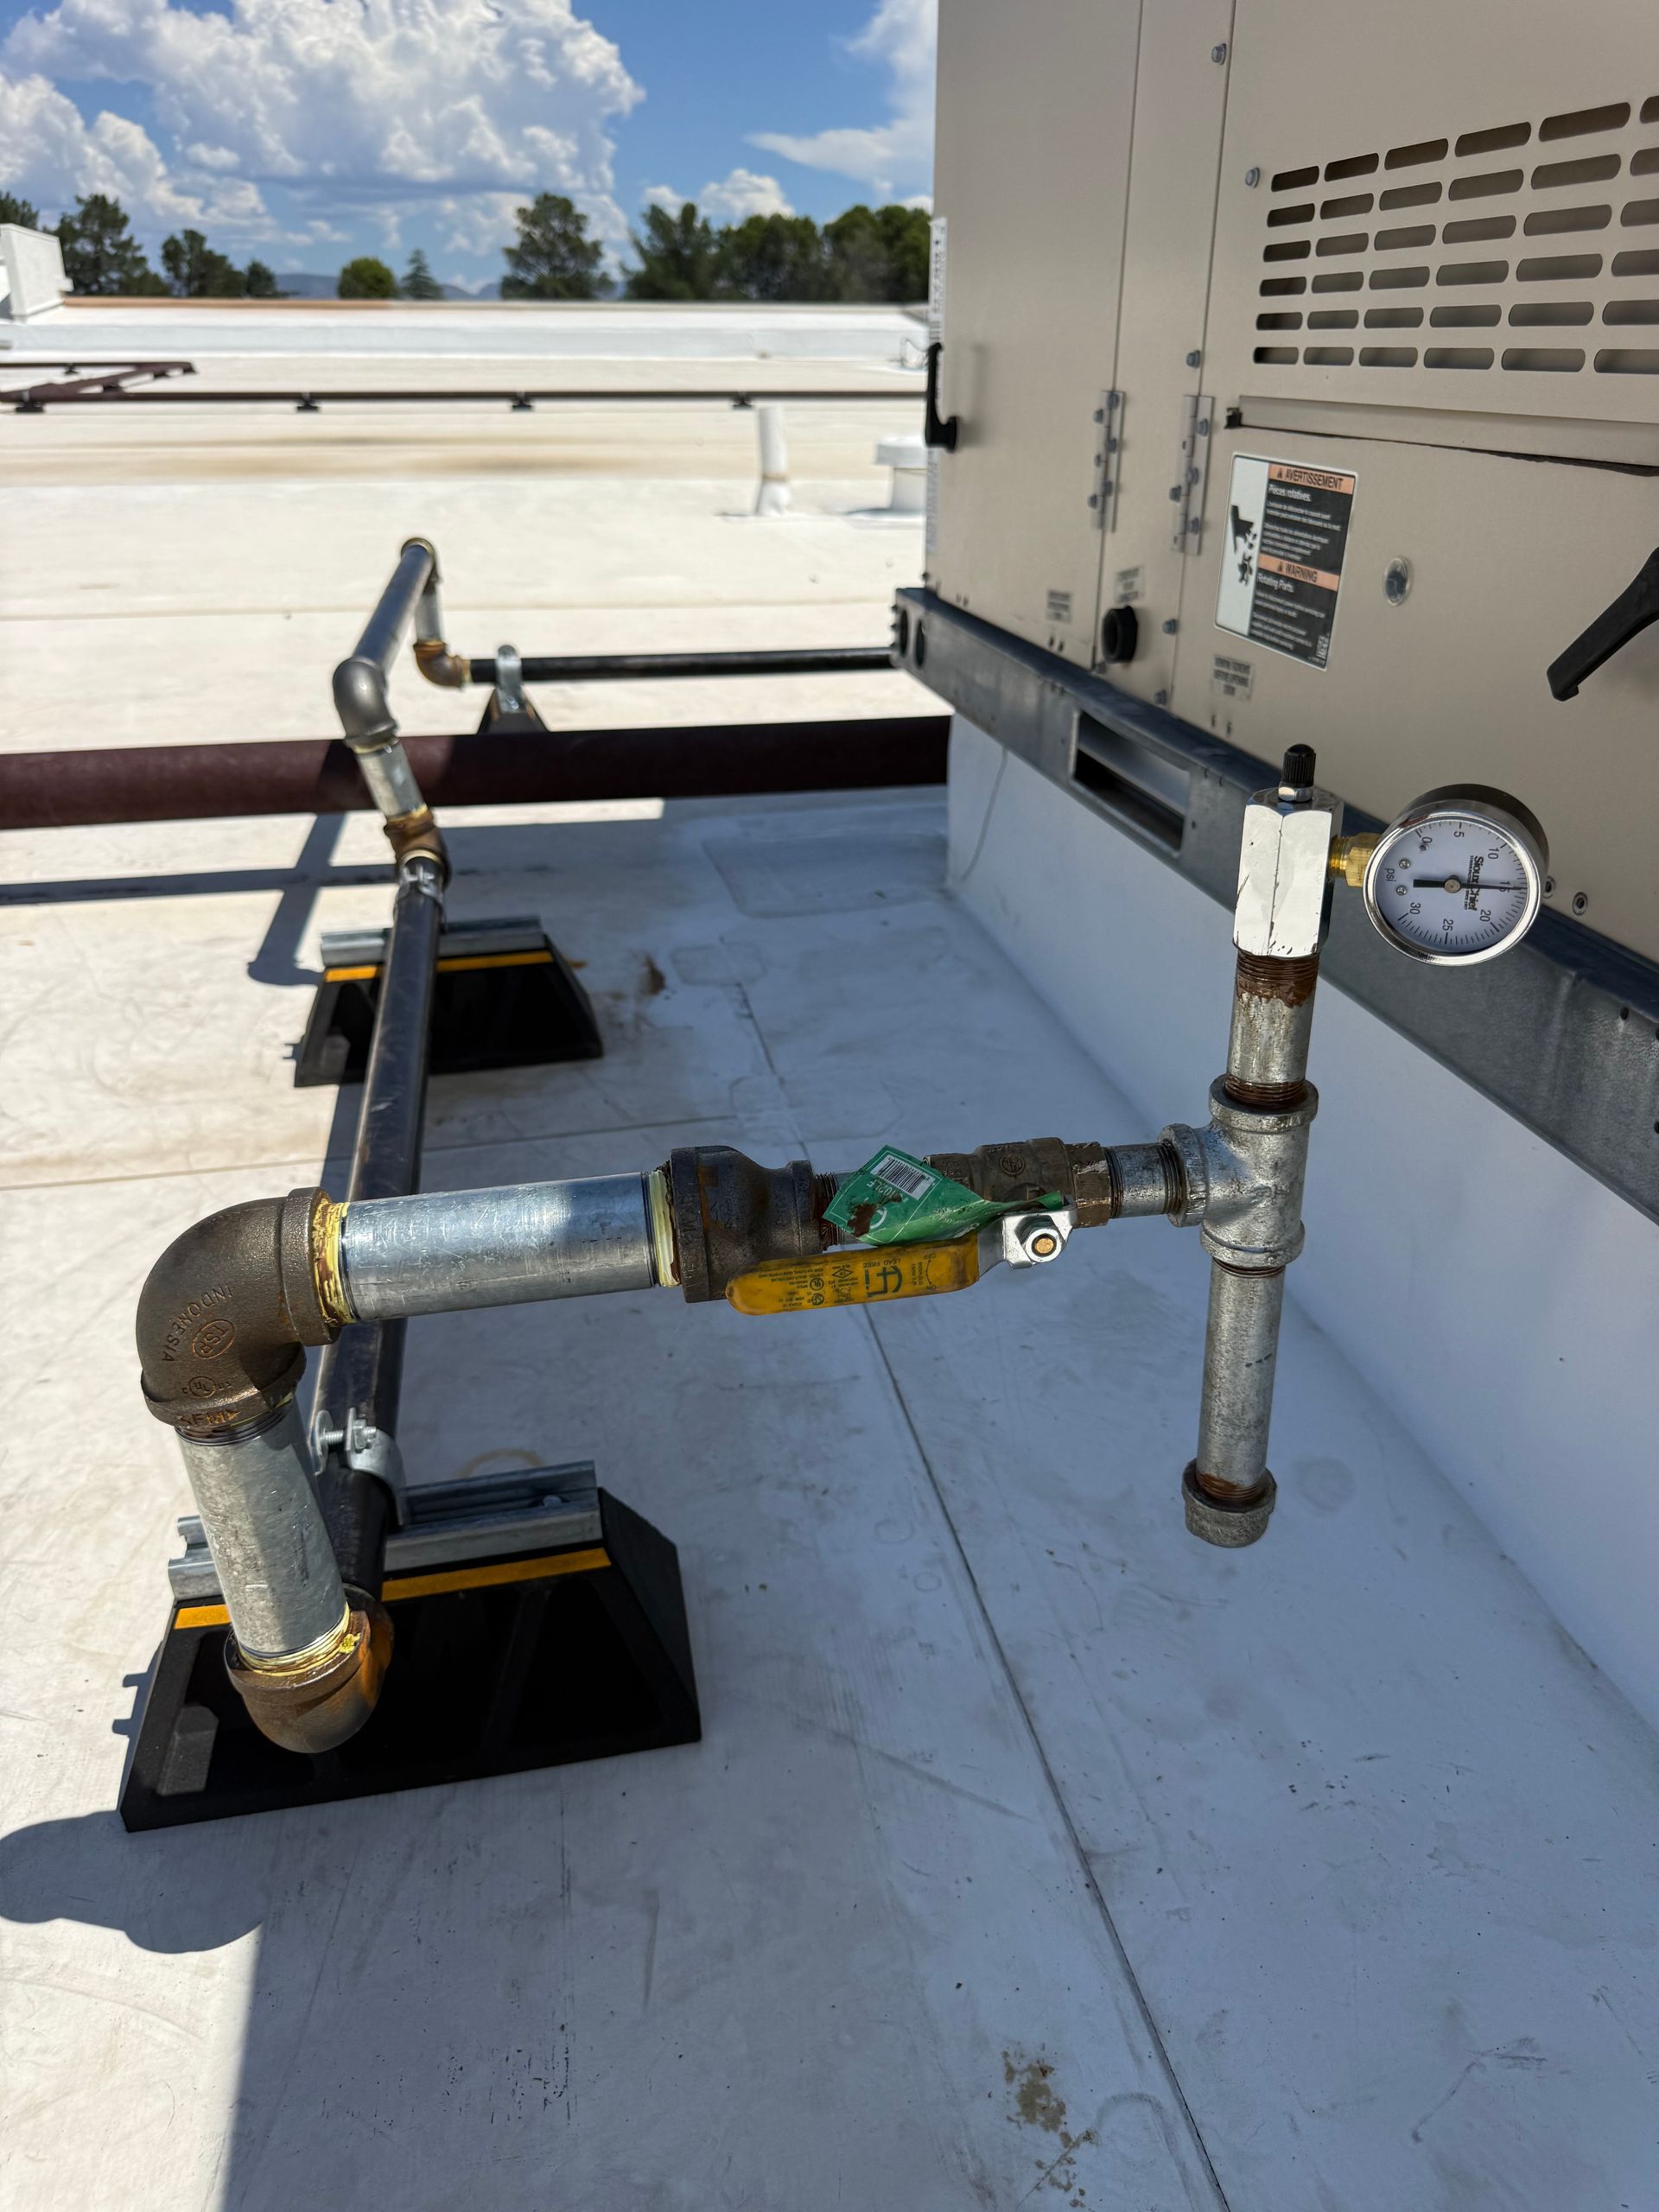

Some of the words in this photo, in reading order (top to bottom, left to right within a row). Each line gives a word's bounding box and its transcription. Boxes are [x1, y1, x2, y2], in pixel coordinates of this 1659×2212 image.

[1285, 468, 1344, 490] AVERTISSEMENT
[1285, 563, 1318, 583] WARNING
[1488, 848, 1501, 860] 10
[1384, 868, 1396, 882] psi
[1473, 855, 1484, 883] Sioux
[1409, 901, 1421, 915] 30
[1479, 910, 1491, 922] 20
[1442, 918, 1453, 931] 25
[883, 1258, 901, 1267] LEAD
[162, 1285, 234, 1363] INDONESIA
